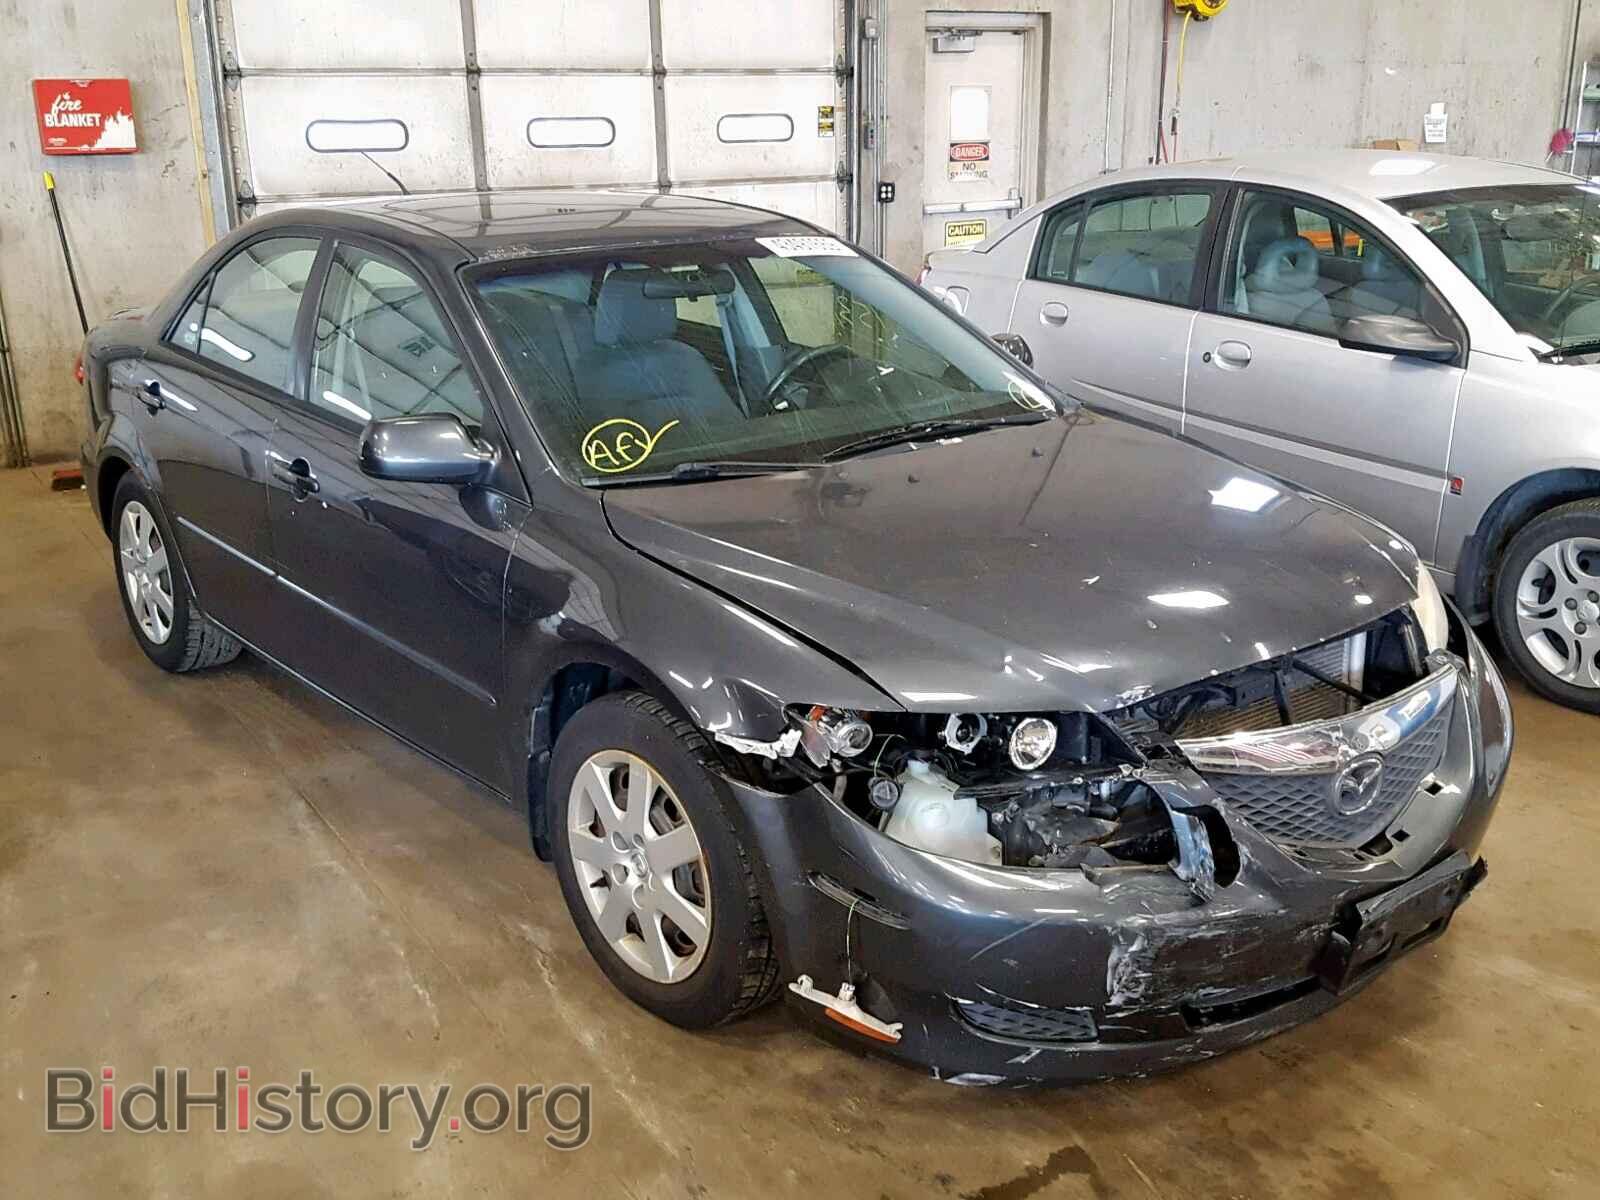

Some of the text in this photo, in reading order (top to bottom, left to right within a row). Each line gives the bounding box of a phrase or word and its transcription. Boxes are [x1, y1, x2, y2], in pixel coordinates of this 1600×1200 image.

[51, 91, 82, 116] fire
[44, 113, 101, 127] BLANKET
[955, 147, 985, 158] DANGER
[962, 162, 976, 171] NO
[949, 223, 984, 236] CAUTION
